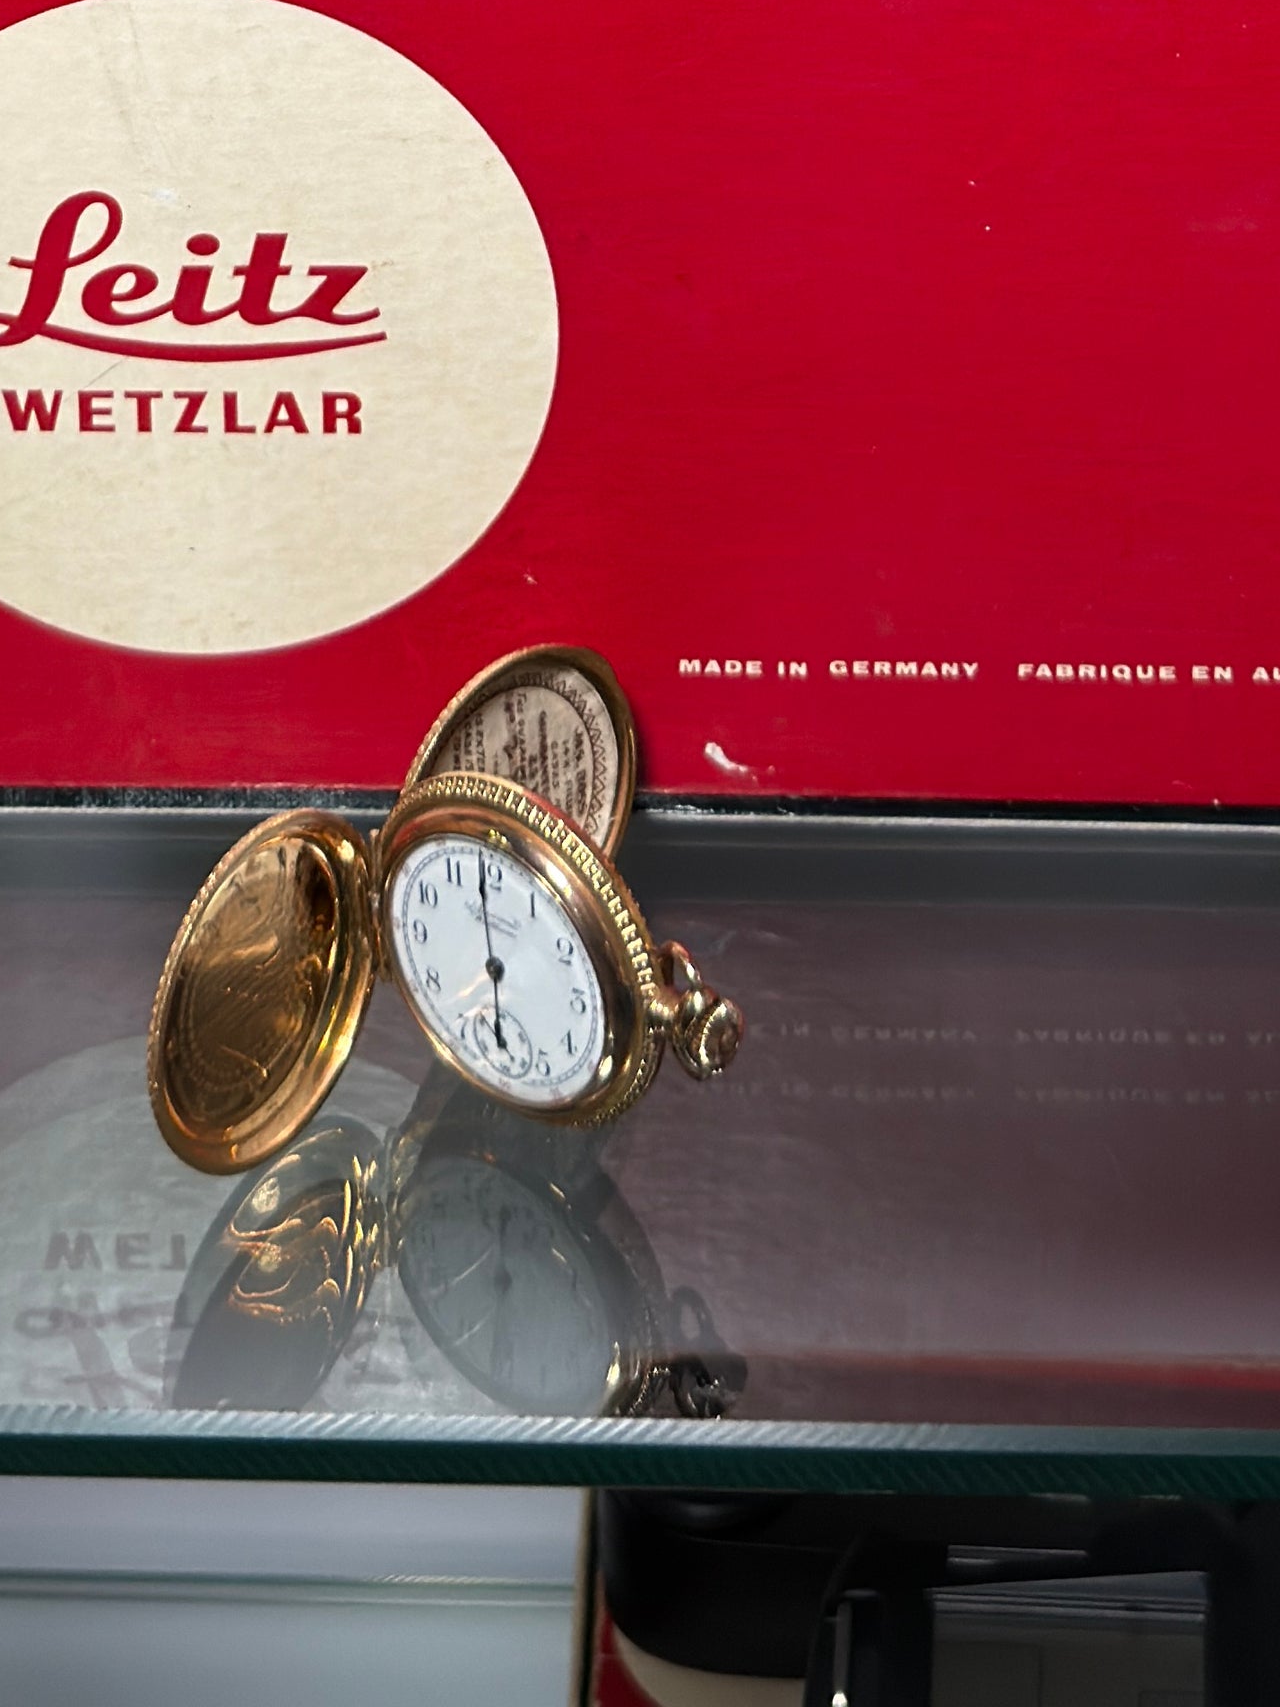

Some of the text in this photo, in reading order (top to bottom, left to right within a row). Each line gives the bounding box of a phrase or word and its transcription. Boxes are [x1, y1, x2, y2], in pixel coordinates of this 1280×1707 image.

[1, 389, 364, 435] WETZLAR
[678, 658, 764, 678] MADE
[777, 660, 809, 678] IN
[829, 661, 981, 680] GERMANY
[1018, 663, 1179, 682] FABRIQUE
[1192, 665, 1234, 683] EN
